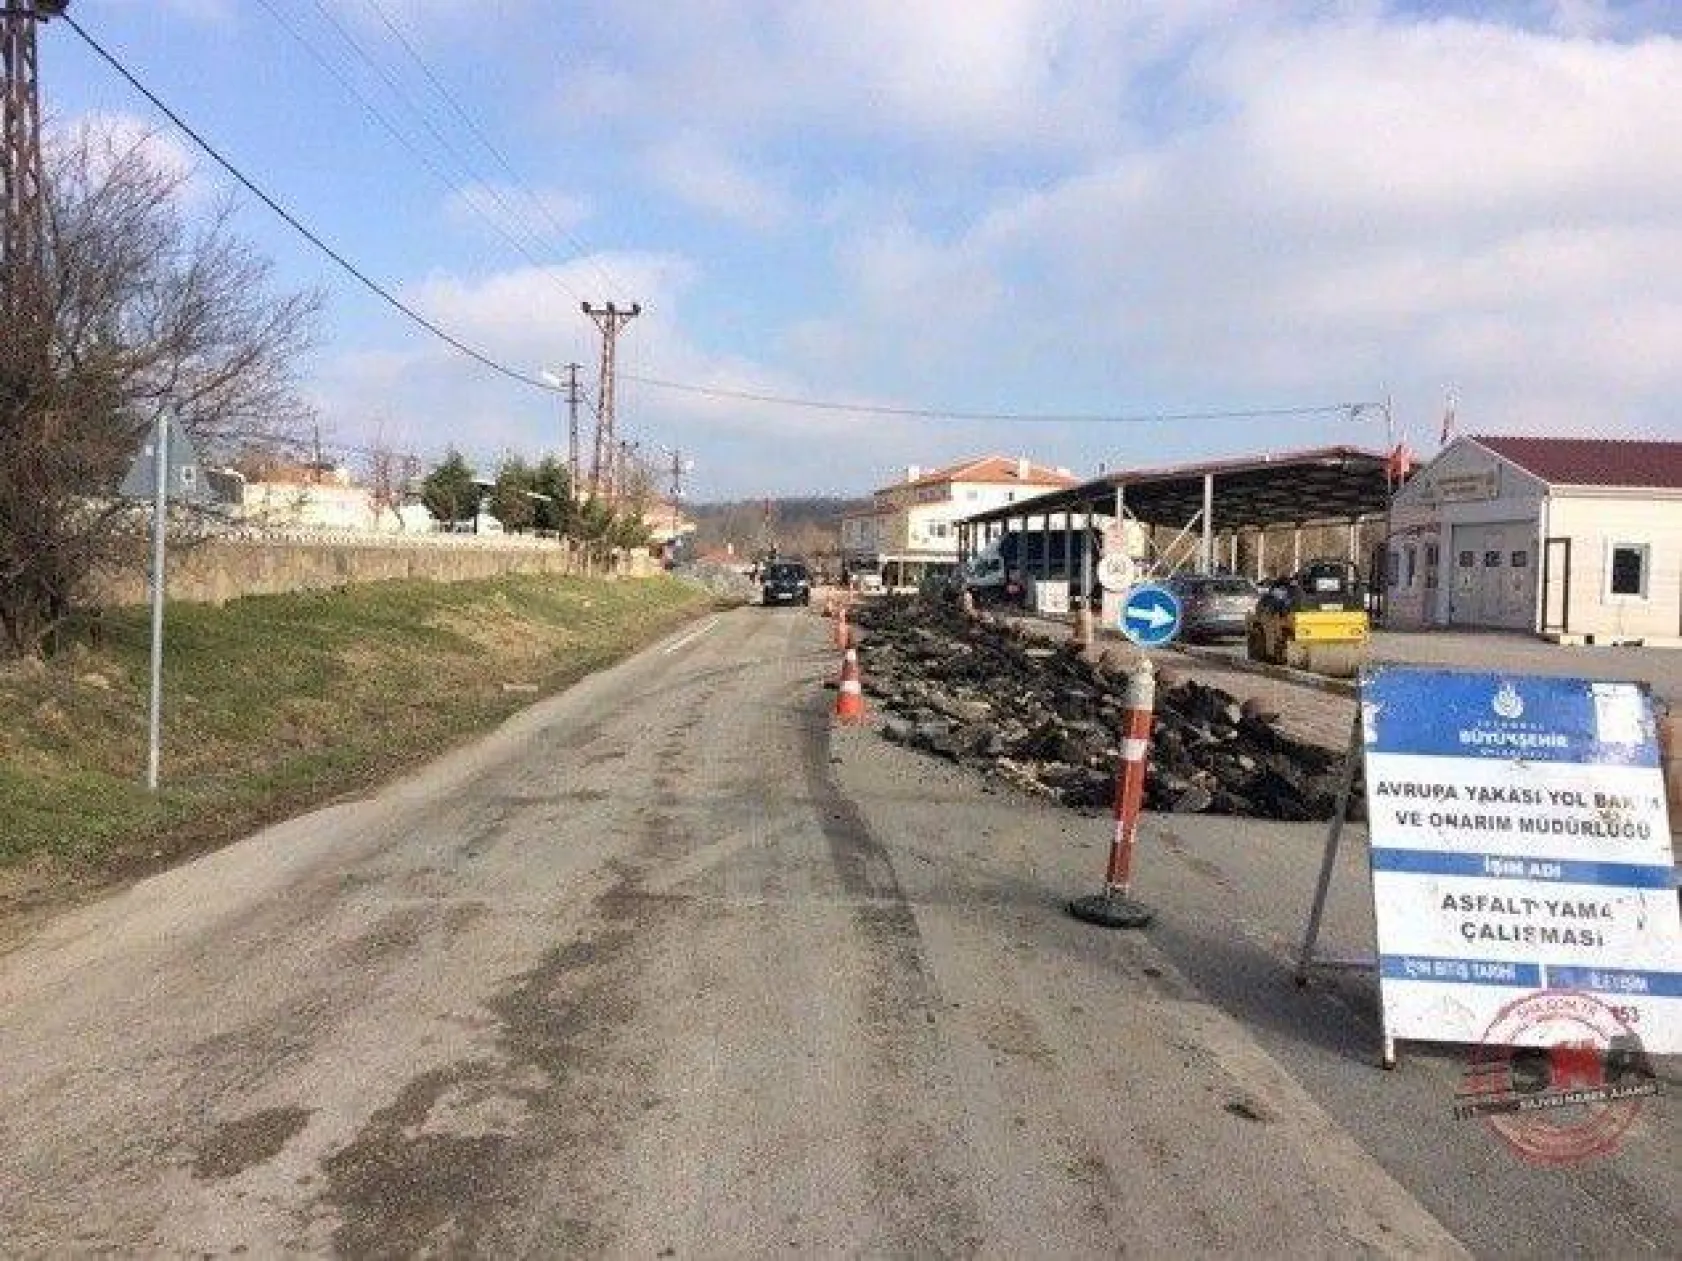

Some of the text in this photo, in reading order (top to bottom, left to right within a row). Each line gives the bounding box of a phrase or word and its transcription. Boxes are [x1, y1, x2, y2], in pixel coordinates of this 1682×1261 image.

[1376, 780, 1459, 800] AVRUPA
[1465, 785, 1542, 804] YAKASI
[1549, 791, 1588, 808] YOL
[1395, 810, 1651, 840] VE ONARIM MÜDÜRLÜĞÜ
[1441, 892, 1534, 915] ASFALT
